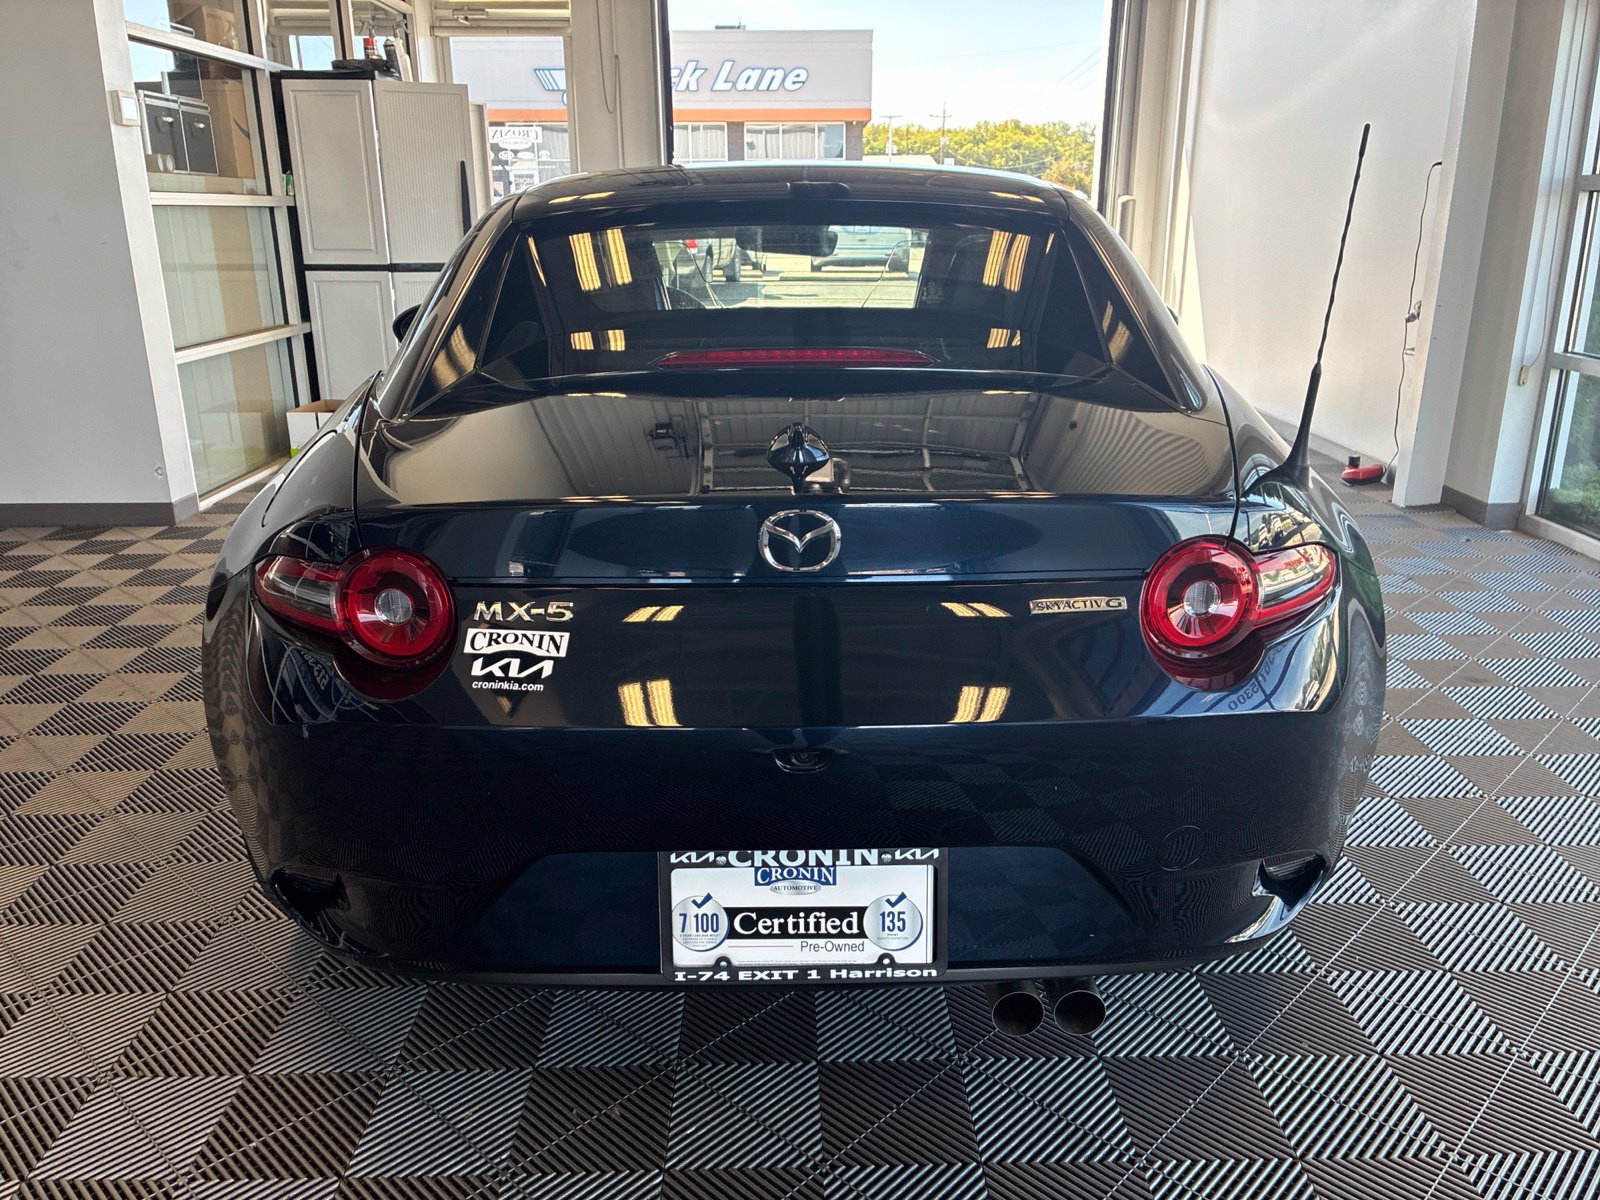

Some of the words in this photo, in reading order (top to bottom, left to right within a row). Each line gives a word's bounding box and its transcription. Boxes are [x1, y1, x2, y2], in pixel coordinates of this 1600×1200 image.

[711, 59, 809, 92] Lane
[473, 601, 574, 622] MX-5
[470, 631, 565, 655] CRONIN
[471, 657, 554, 679] KIA
[472, 680, 544, 692] croninkia.com
[670, 851, 715, 863] KIA
[728, 849, 879, 867] CRONIN
[895, 848, 940, 860] KIA
[757, 866, 835, 885] CRONIN
[679, 913, 687, 933] 7
[693, 913, 719, 933] 100
[734, 911, 860, 934] Certified
[880, 911, 906, 932] 135
[800, 941, 865, 952] Pre-Owned
[674, 972, 730, 981] I-74
[738, 970, 799, 980] EXIT
[807, 970, 821, 979] 1
[829, 968, 938, 979] Harrison
